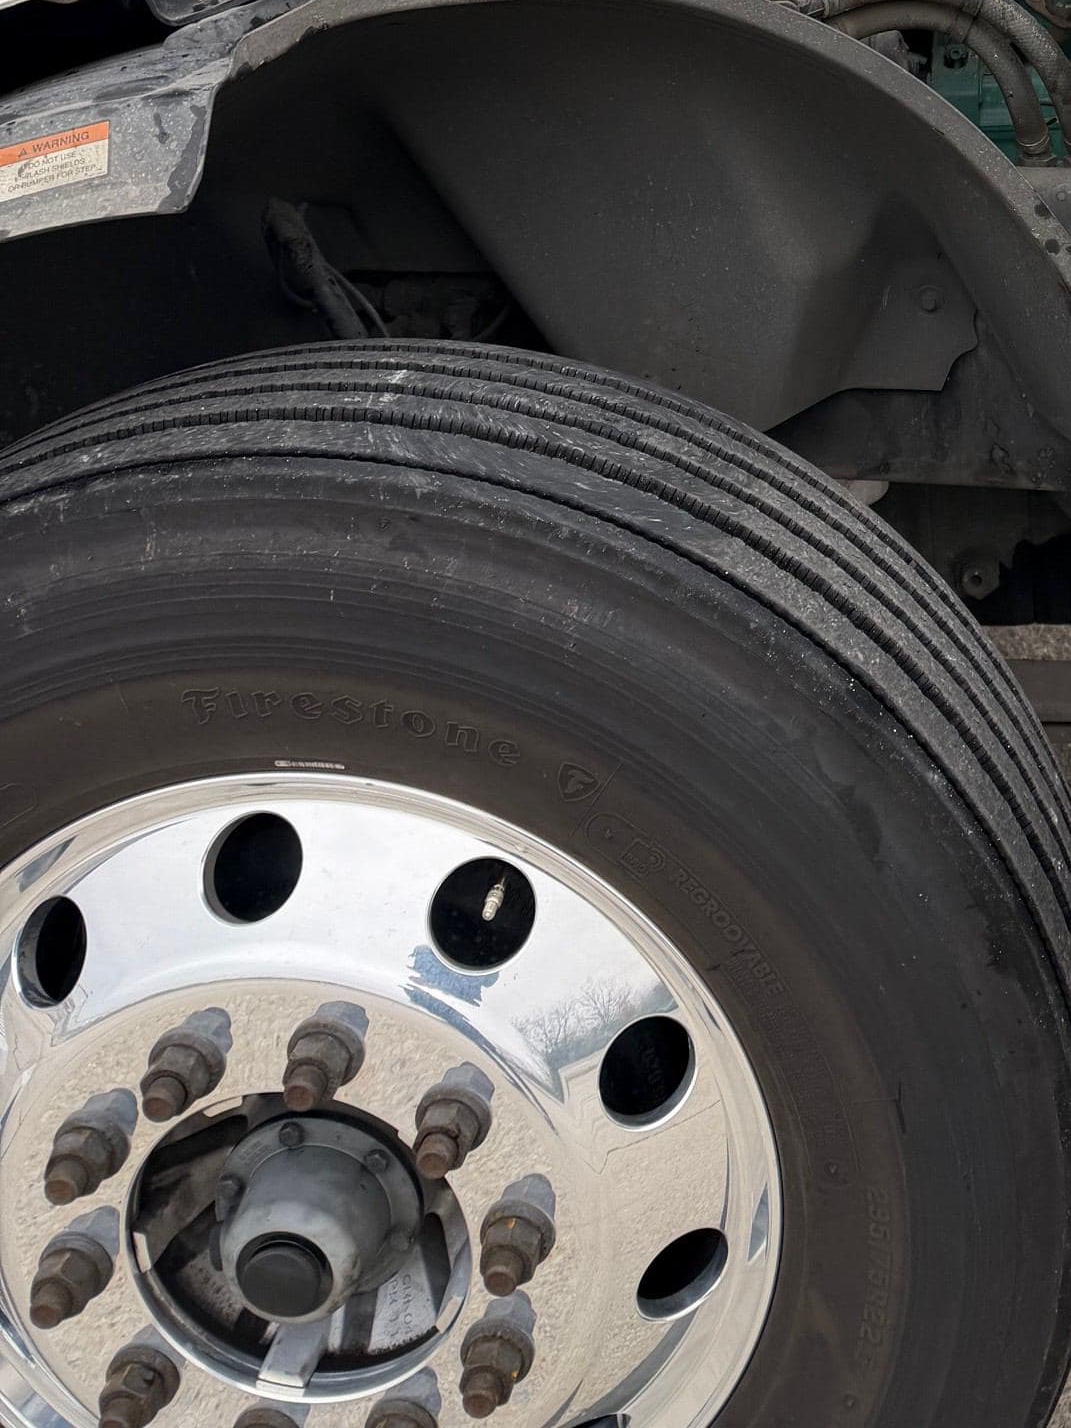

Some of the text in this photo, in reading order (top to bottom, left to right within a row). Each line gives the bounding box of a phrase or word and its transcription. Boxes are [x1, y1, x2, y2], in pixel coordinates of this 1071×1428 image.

[32, 131, 90, 154] WARNING
[29, 152, 77, 169] DO NOT USE
[52, 158, 85, 171] SHIELDS
[56, 169, 73, 179] FOR
[181, 685, 521, 766] Firestone
[669, 868, 784, 996] REGROOVABLE
